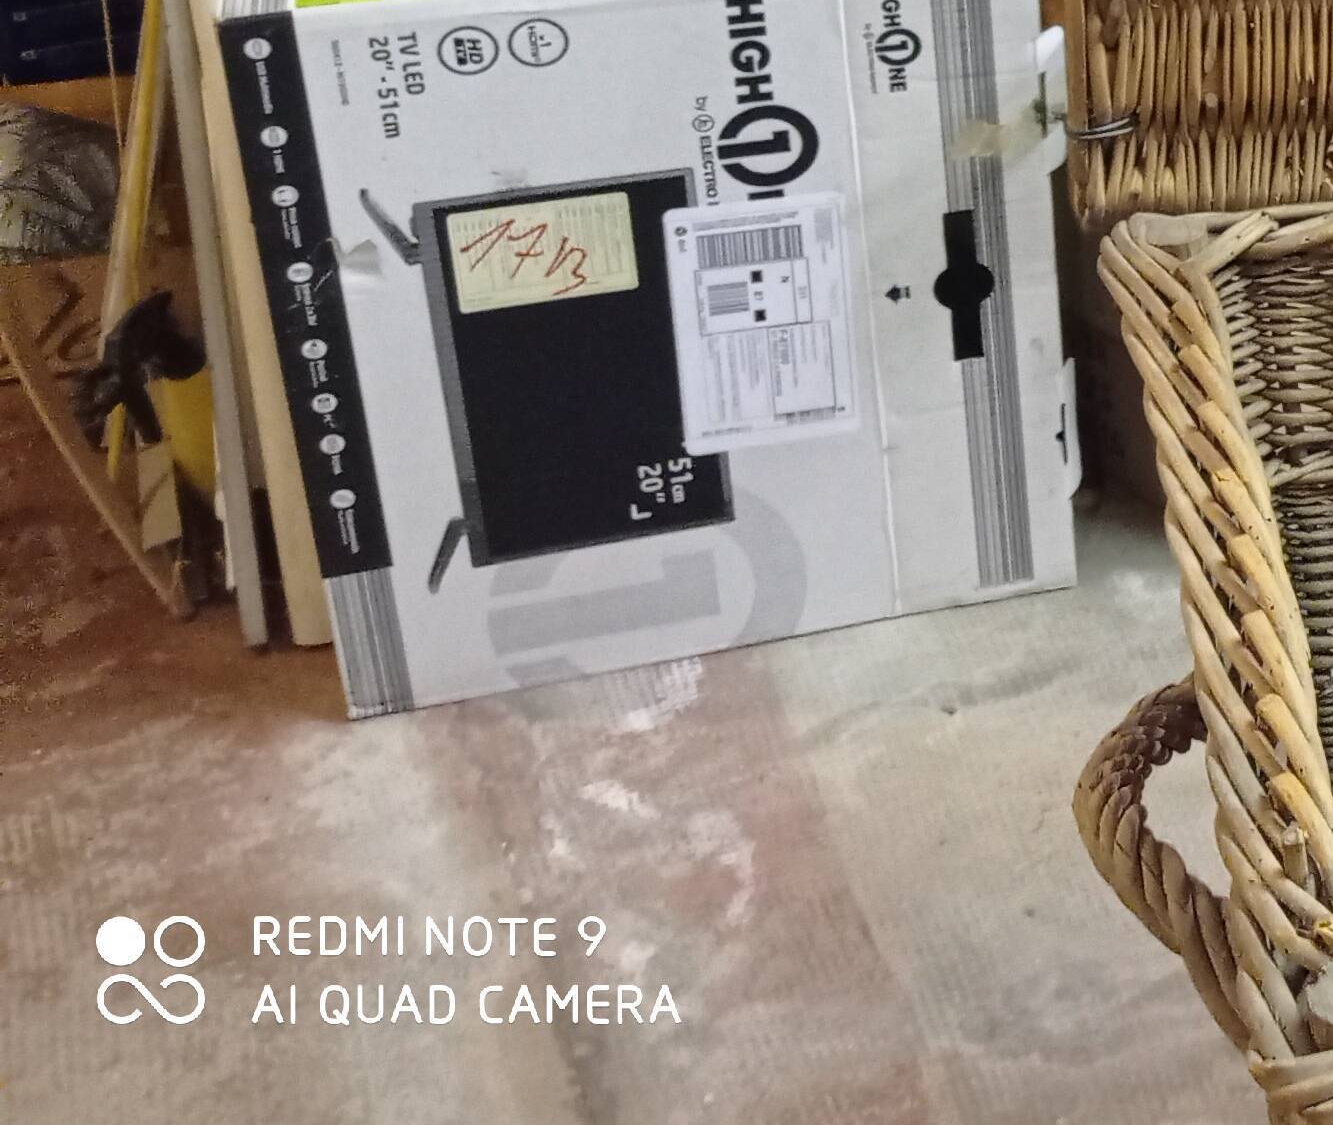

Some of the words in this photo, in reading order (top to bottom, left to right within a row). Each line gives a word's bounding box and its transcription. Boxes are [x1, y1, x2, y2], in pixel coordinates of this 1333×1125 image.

[397, 31, 420, 57] TV
[402, 61, 426, 96] LED
[699, 135, 719, 200] ELECTRO
